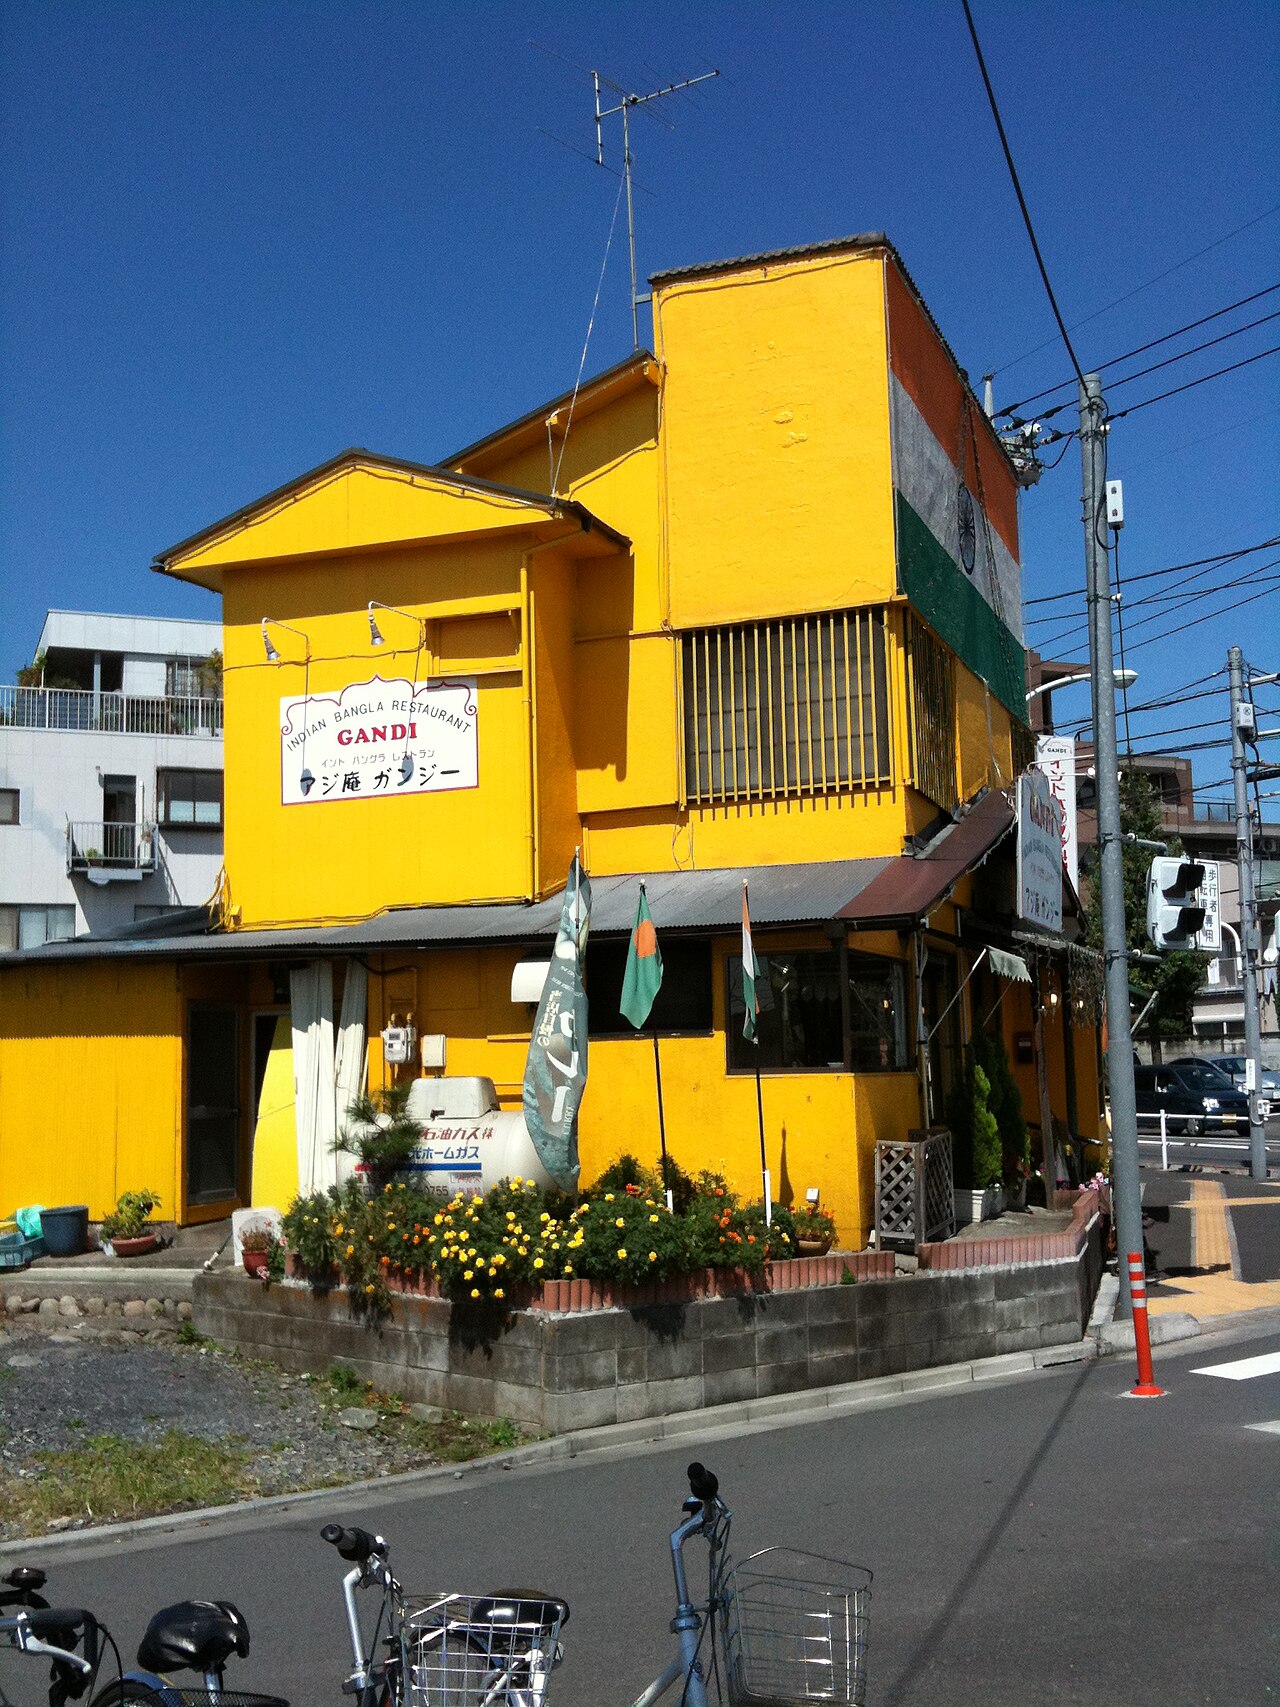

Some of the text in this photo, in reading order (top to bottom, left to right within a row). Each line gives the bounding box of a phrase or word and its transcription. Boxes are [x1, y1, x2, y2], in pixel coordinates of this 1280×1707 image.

[287, 700, 472, 751] INDIAN BANGLA RESTAURANT
[337, 722, 418, 746] GANDI
[373, 763, 460, 787] ガンジー
